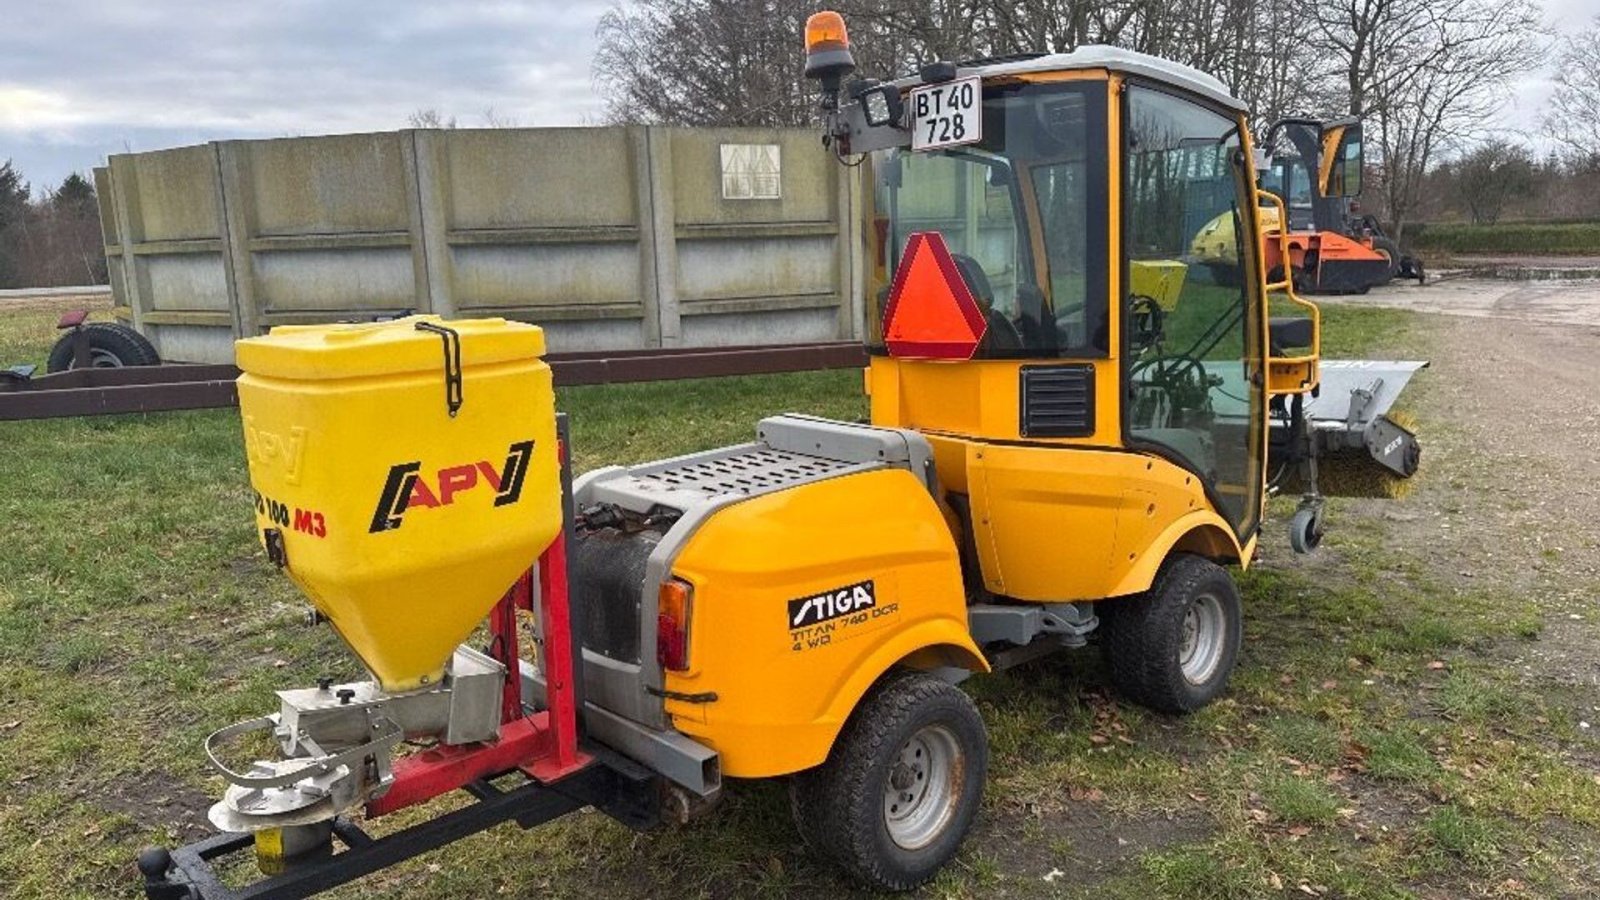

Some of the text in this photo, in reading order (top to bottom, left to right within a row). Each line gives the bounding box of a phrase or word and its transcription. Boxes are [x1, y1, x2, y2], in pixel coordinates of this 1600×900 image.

[917, 83, 973, 118] BT 40
[926, 113, 965, 143] 728
[265, 497, 290, 528] 100
[293, 507, 327, 538] M3
[793, 586, 873, 626] STIGA
[791, 623, 836, 641] TITAN
[840, 613, 868, 628] 740
[792, 635, 831, 652] 4 WD
